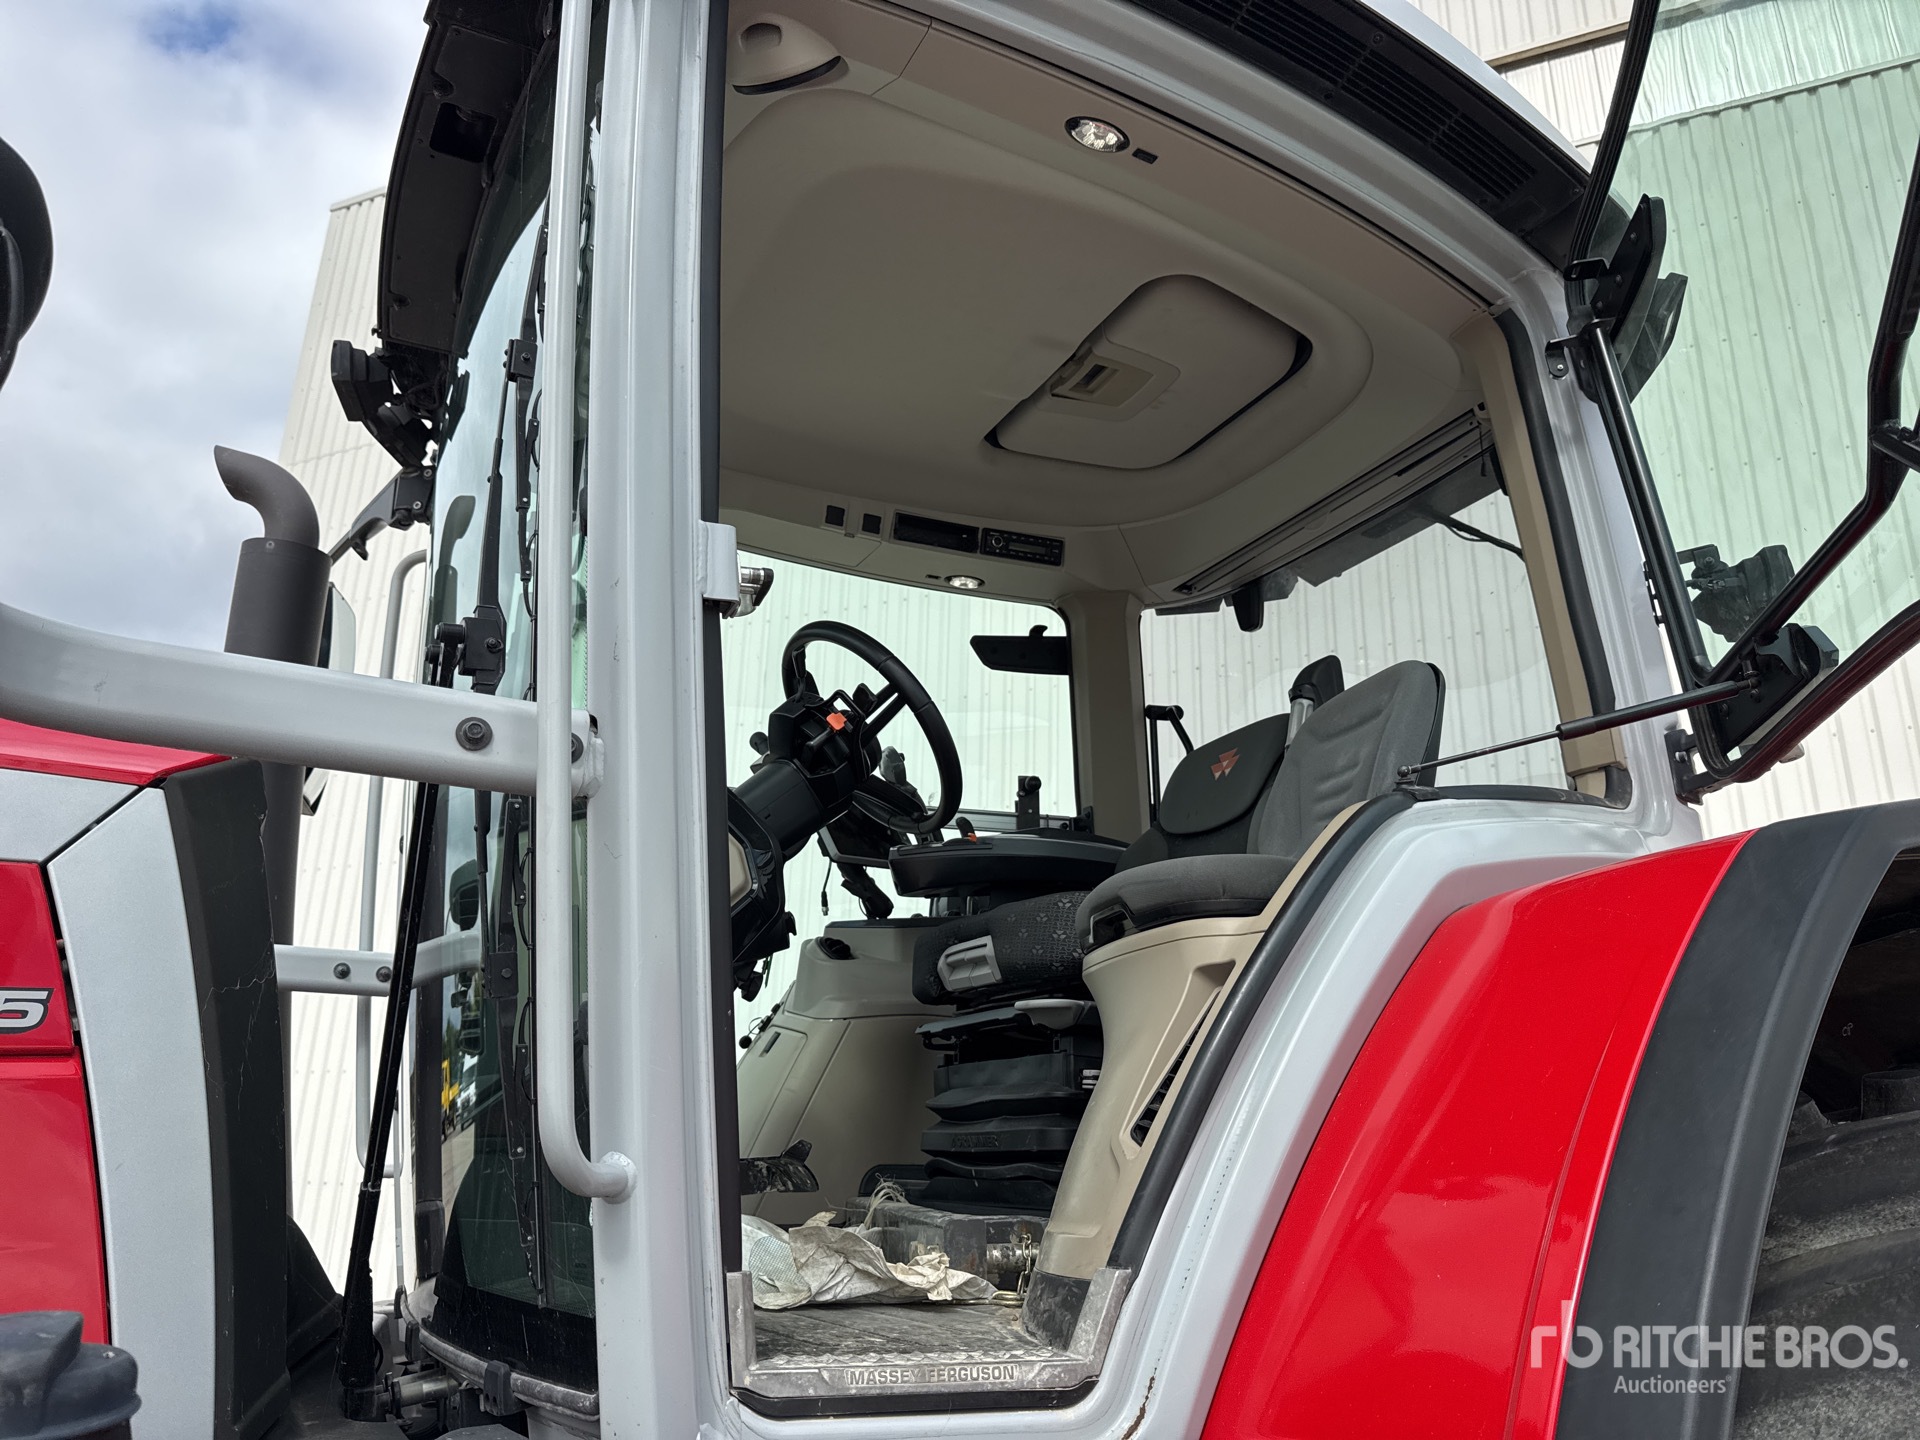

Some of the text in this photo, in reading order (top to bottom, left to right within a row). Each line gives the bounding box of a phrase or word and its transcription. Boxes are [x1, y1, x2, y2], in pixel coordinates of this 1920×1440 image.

[0, 987, 54, 1034] 5
[850, 1365, 1015, 1385] MASSEY FERGUSON
